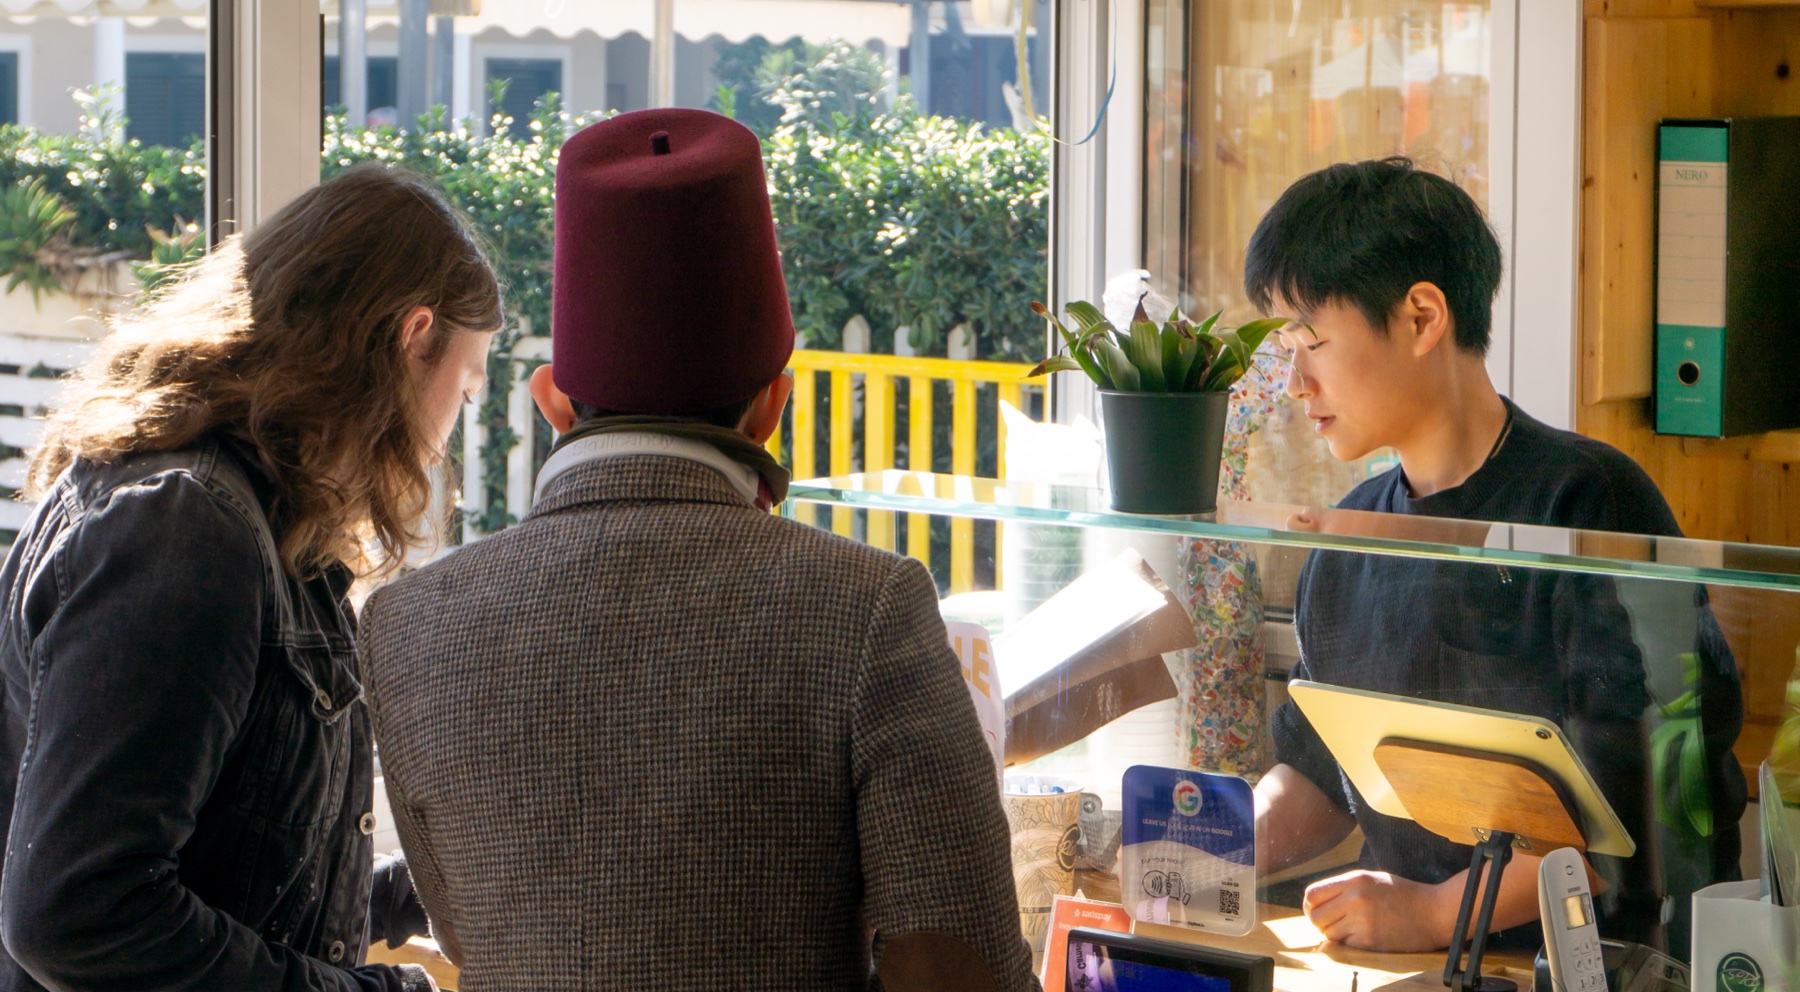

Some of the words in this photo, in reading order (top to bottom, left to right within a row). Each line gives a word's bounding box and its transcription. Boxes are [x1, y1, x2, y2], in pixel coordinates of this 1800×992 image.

[1675, 169, 1708, 180] NERO
[1142, 818, 1159, 826] LEAVE
[1211, 827, 1233, 837] GOOGLE
[1081, 905, 1112, 922] satispay
